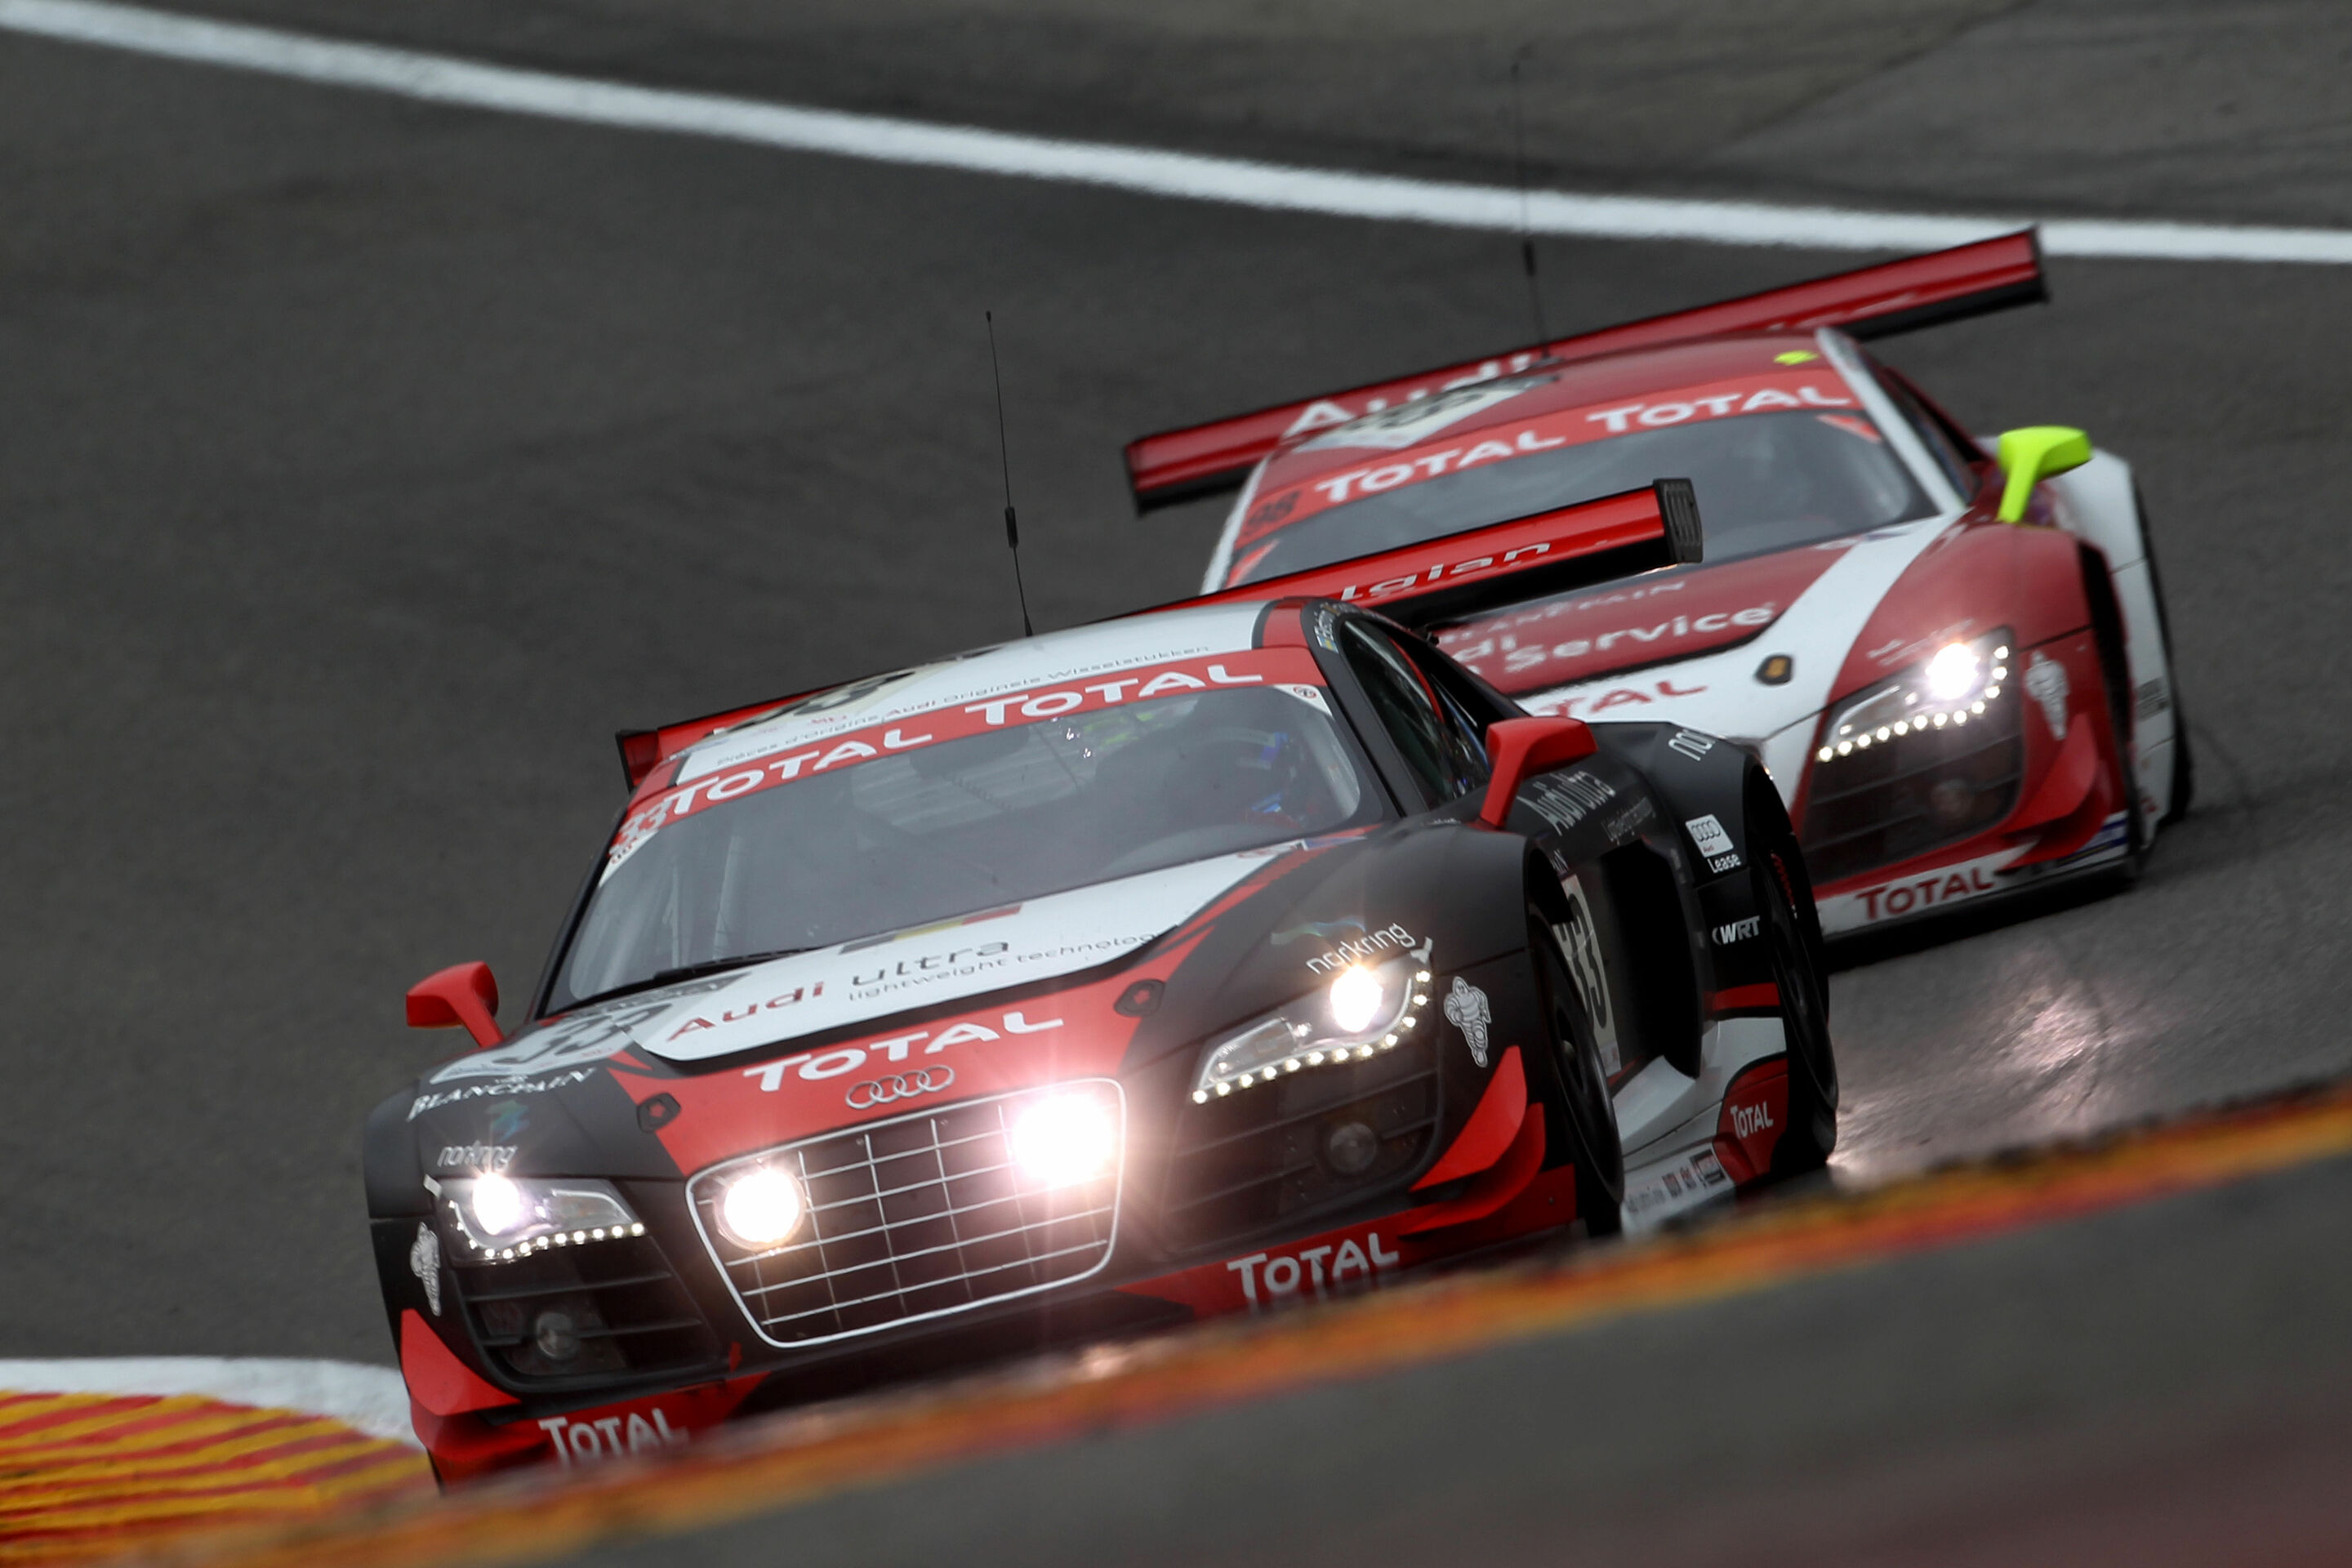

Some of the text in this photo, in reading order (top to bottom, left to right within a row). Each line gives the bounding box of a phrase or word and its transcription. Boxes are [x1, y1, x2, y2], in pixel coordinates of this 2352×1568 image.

[1314, 430, 1566, 503] TOTAL
[1585, 386, 1851, 433] TOTAL
[1340, 542, 1551, 602] lgian
[1504, 607, 1775, 673] Service
[884, 698, 937, 720] Audi
[1536, 680, 1708, 716] TAL
[662, 728, 933, 816] TOTAL
[964, 664, 1263, 726] TOTAL
[1707, 853, 1741, 874] Lease
[1857, 867, 1993, 920] TOTAL
[1306, 922, 1417, 975] norkring
[1718, 915, 1760, 945] WRT
[665, 981, 823, 1042] Audi
[852, 940, 1009, 986] ultra
[849, 958, 1004, 1002] lightweight
[742, 1010, 1064, 1092] TOTAL
[1730, 1101, 1774, 1139] TOTAL
[1226, 1232, 1400, 1300] TOTAL
[537, 1407, 688, 1467] TOTAL
